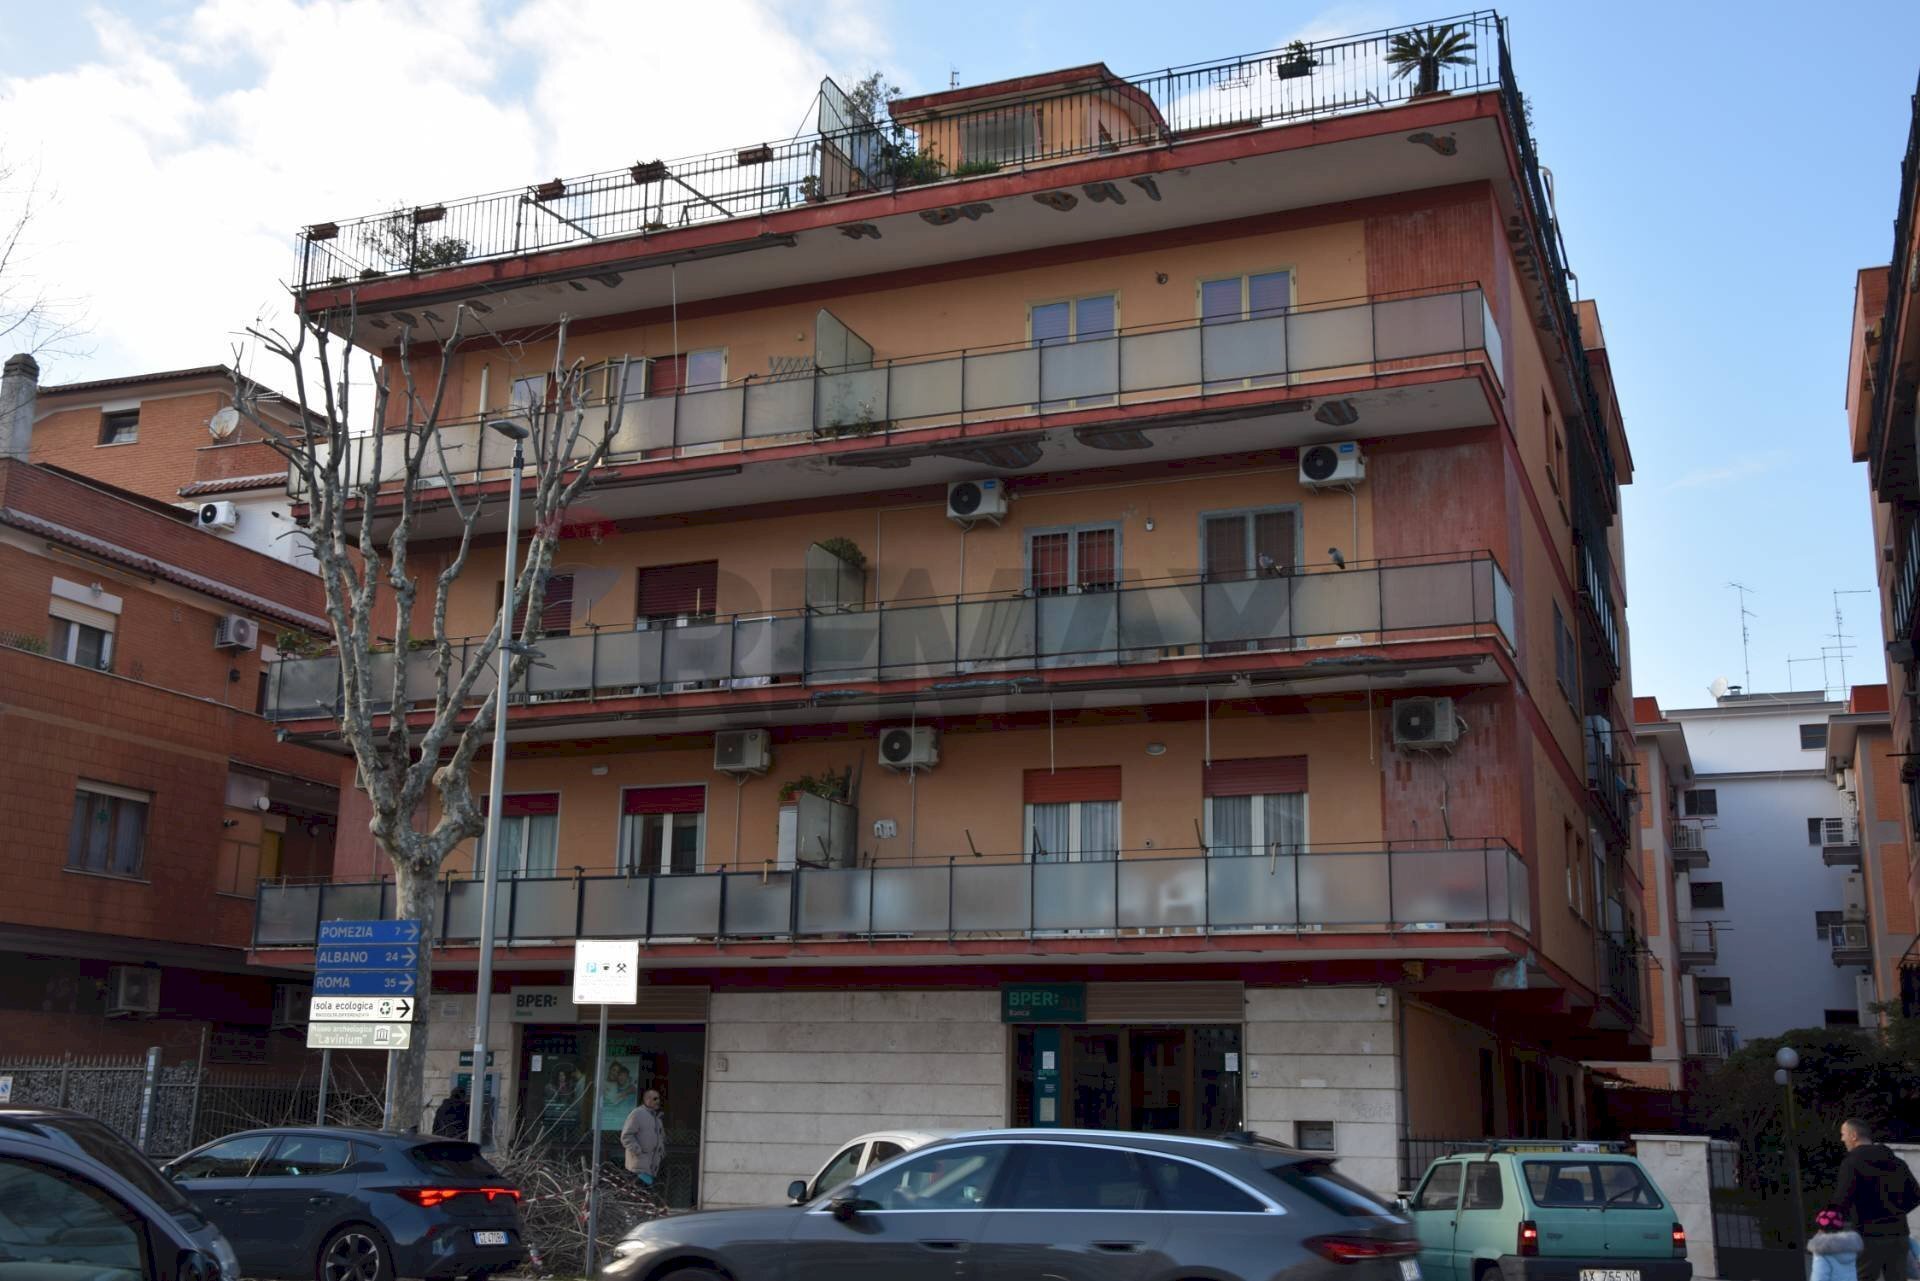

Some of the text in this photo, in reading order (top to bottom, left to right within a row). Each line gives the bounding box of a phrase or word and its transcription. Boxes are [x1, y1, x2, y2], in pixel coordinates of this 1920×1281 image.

[321, 926, 401, 938] POMEZIA 7
[319, 951, 398, 963] ALBANO 24
[316, 976, 396, 988] ROMA 35
[313, 1000, 374, 1011] isola ecologica
